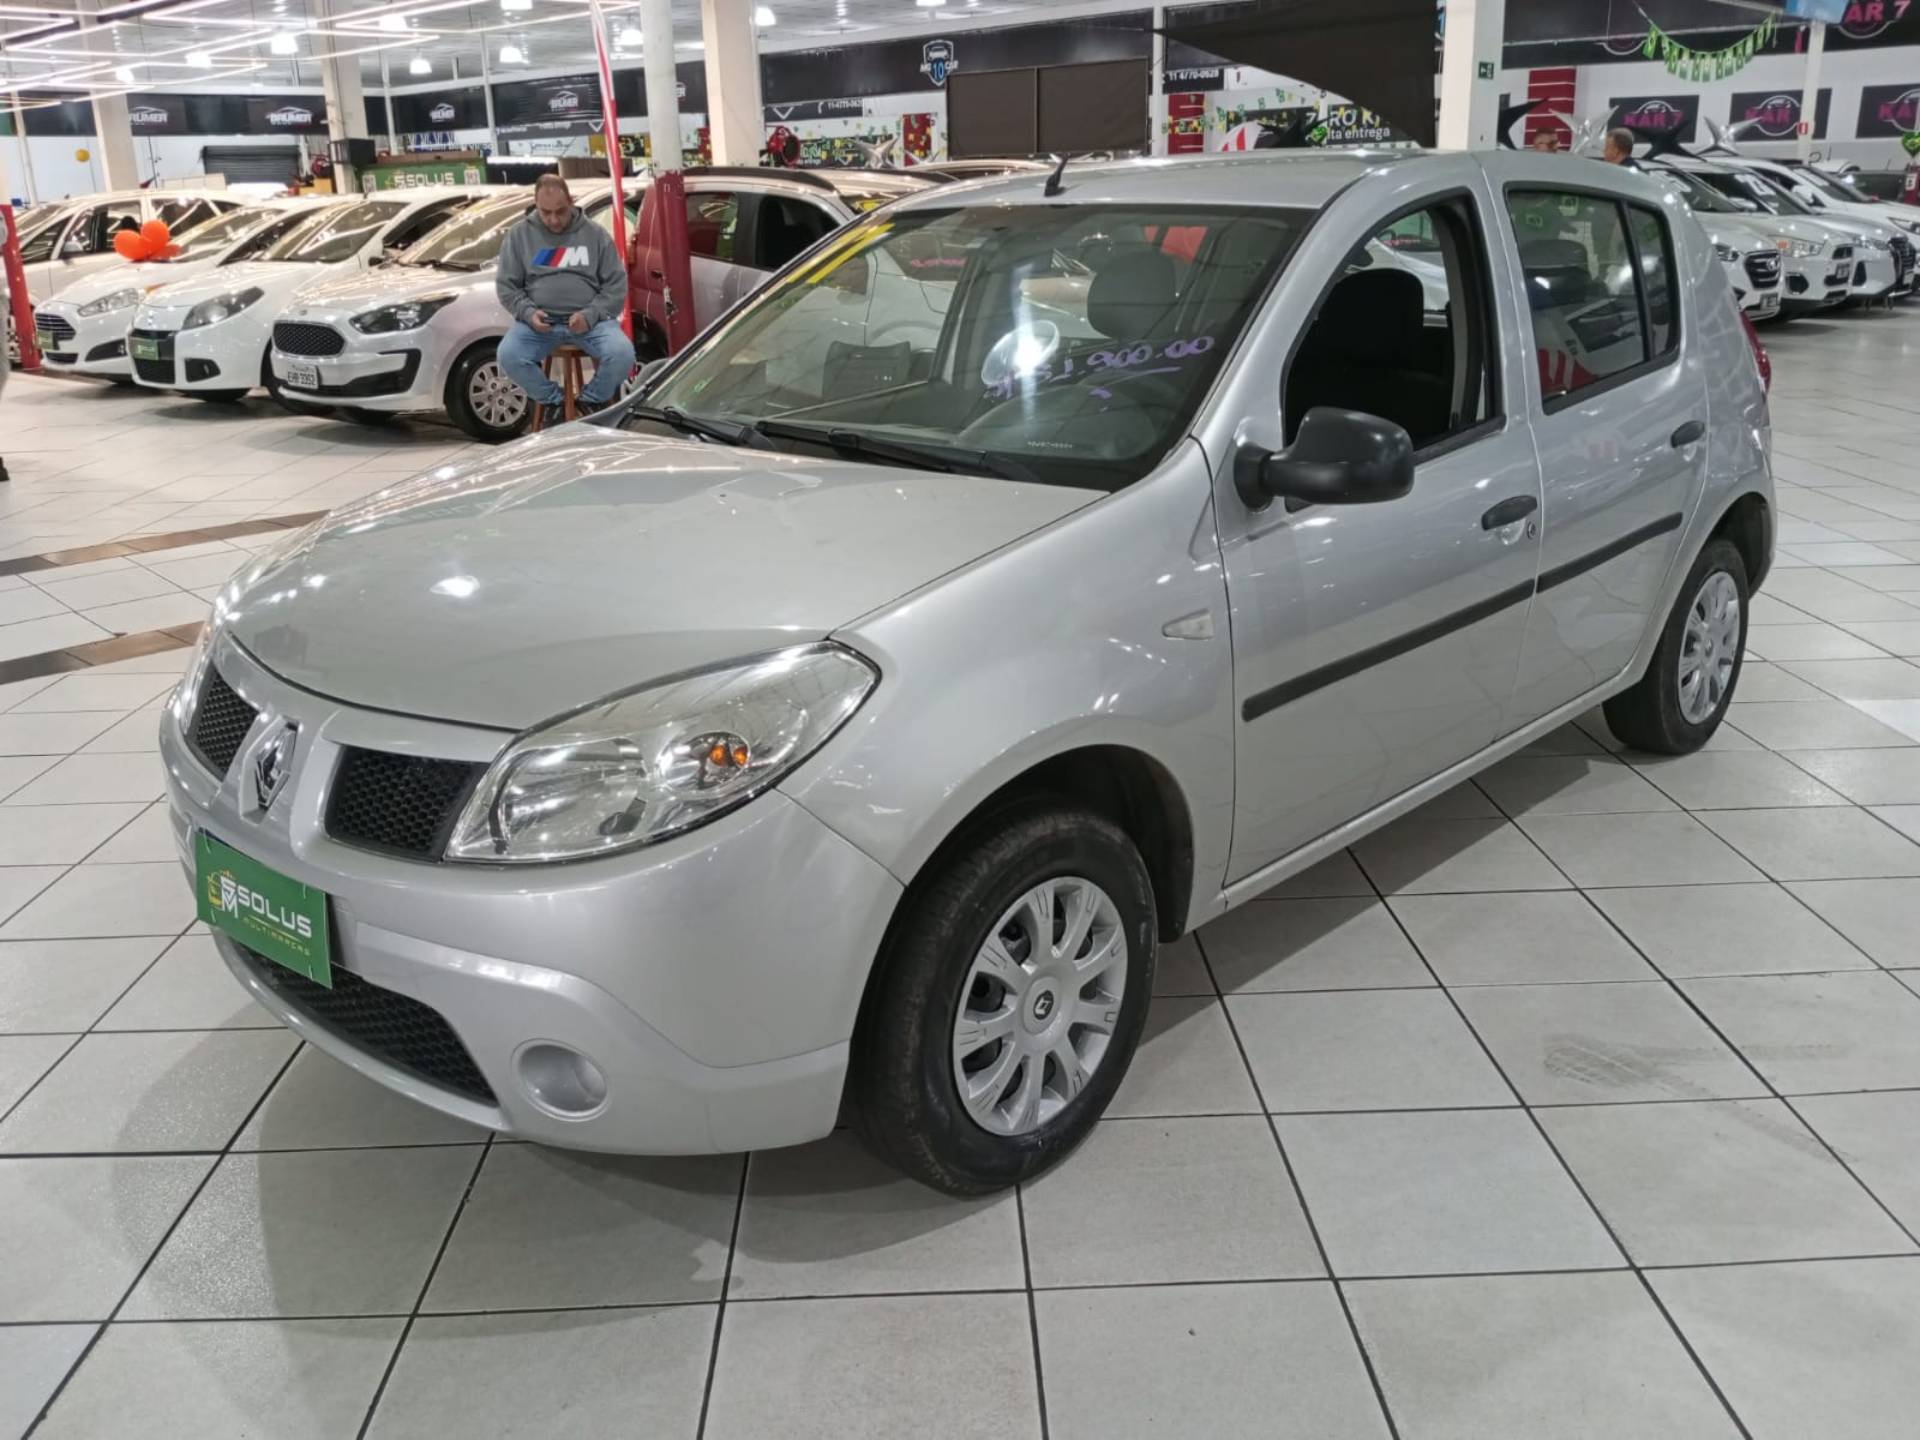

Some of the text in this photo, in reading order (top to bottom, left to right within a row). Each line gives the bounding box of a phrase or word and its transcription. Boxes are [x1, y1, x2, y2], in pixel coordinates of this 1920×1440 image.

[1842, 2, 1884, 22] AR
[1345, 126, 1391, 141] entrega
[406, 172, 455, 187] SOLUS
[237, 884, 312, 938] SOLUS
